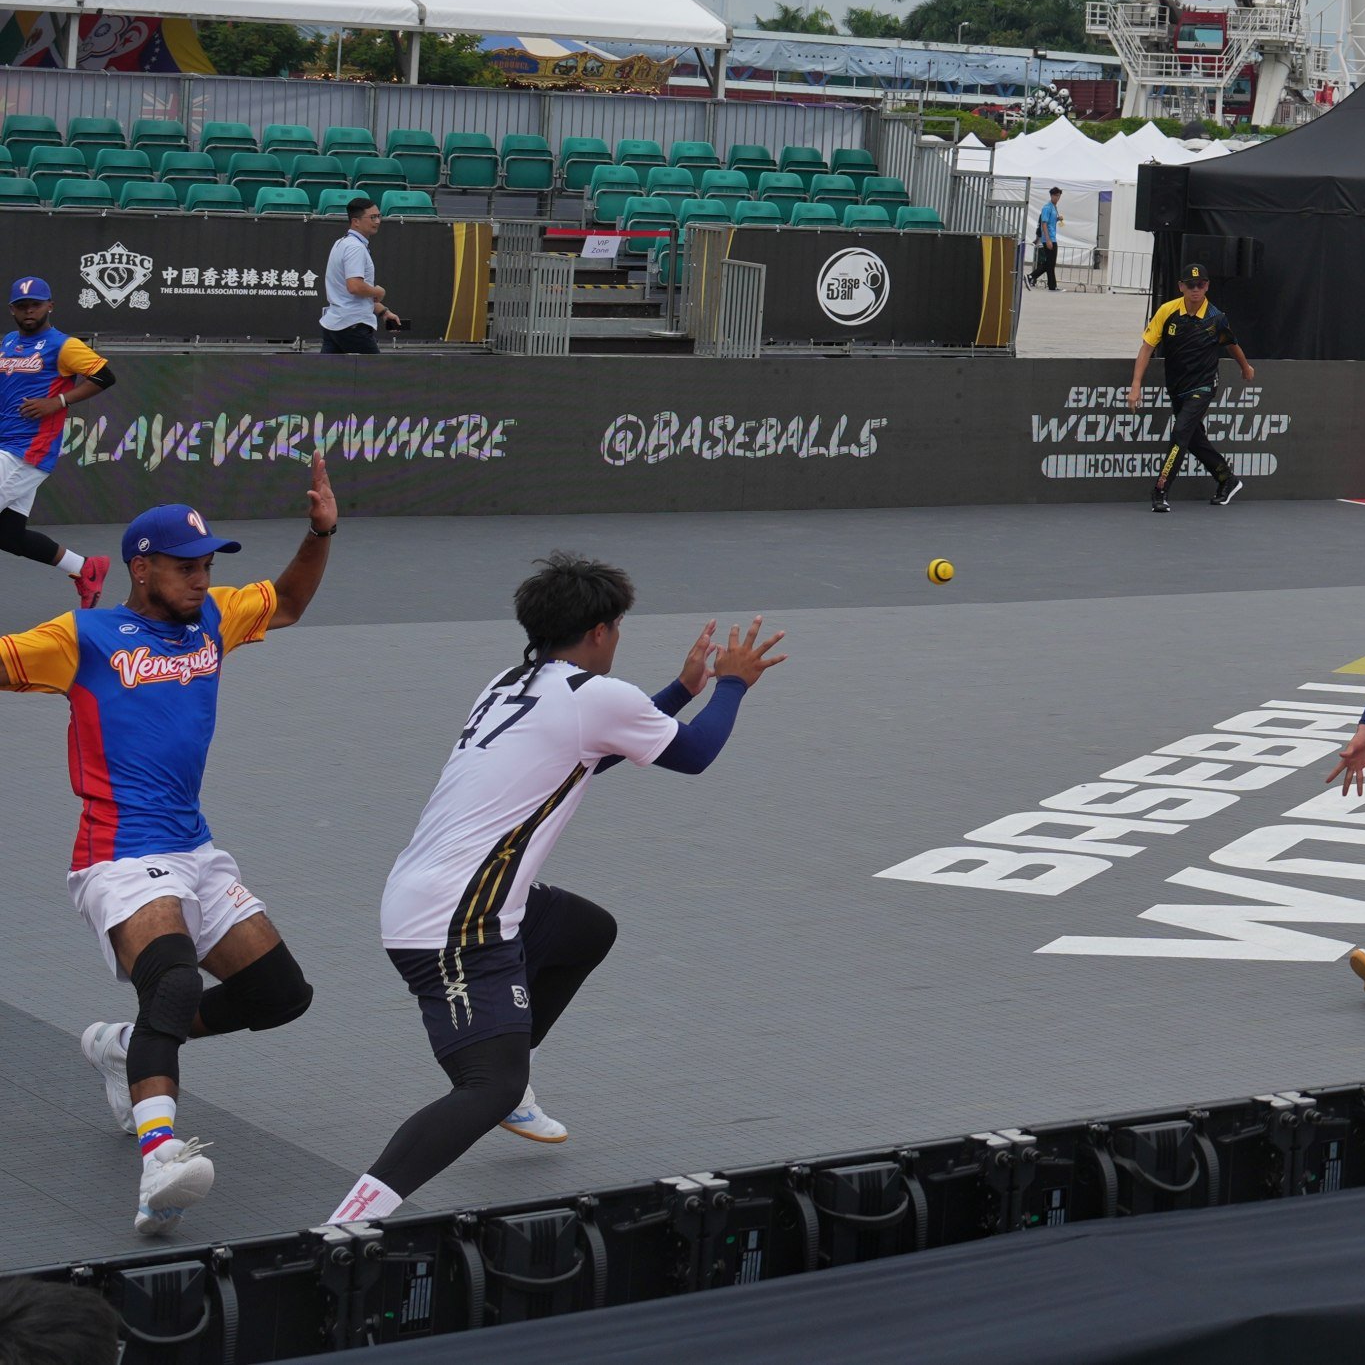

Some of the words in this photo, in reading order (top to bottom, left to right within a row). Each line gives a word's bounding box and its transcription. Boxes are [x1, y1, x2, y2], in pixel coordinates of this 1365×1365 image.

[597, 239, 610, 247] VIP
[80, 251, 153, 272] BAHKC
[161, 266, 319, 288] 中國香港棒球總會
[174, 287, 205, 295] BASEBALL
[206, 288, 249, 296] ASSOCIATION
[276, 289, 298, 297] KONG,
[298, 289, 318, 297] CHINA
[1202, 413, 1292, 442] CUP
[1087, 457, 1135, 475] HONG
[457, 692, 543, 750] 47
